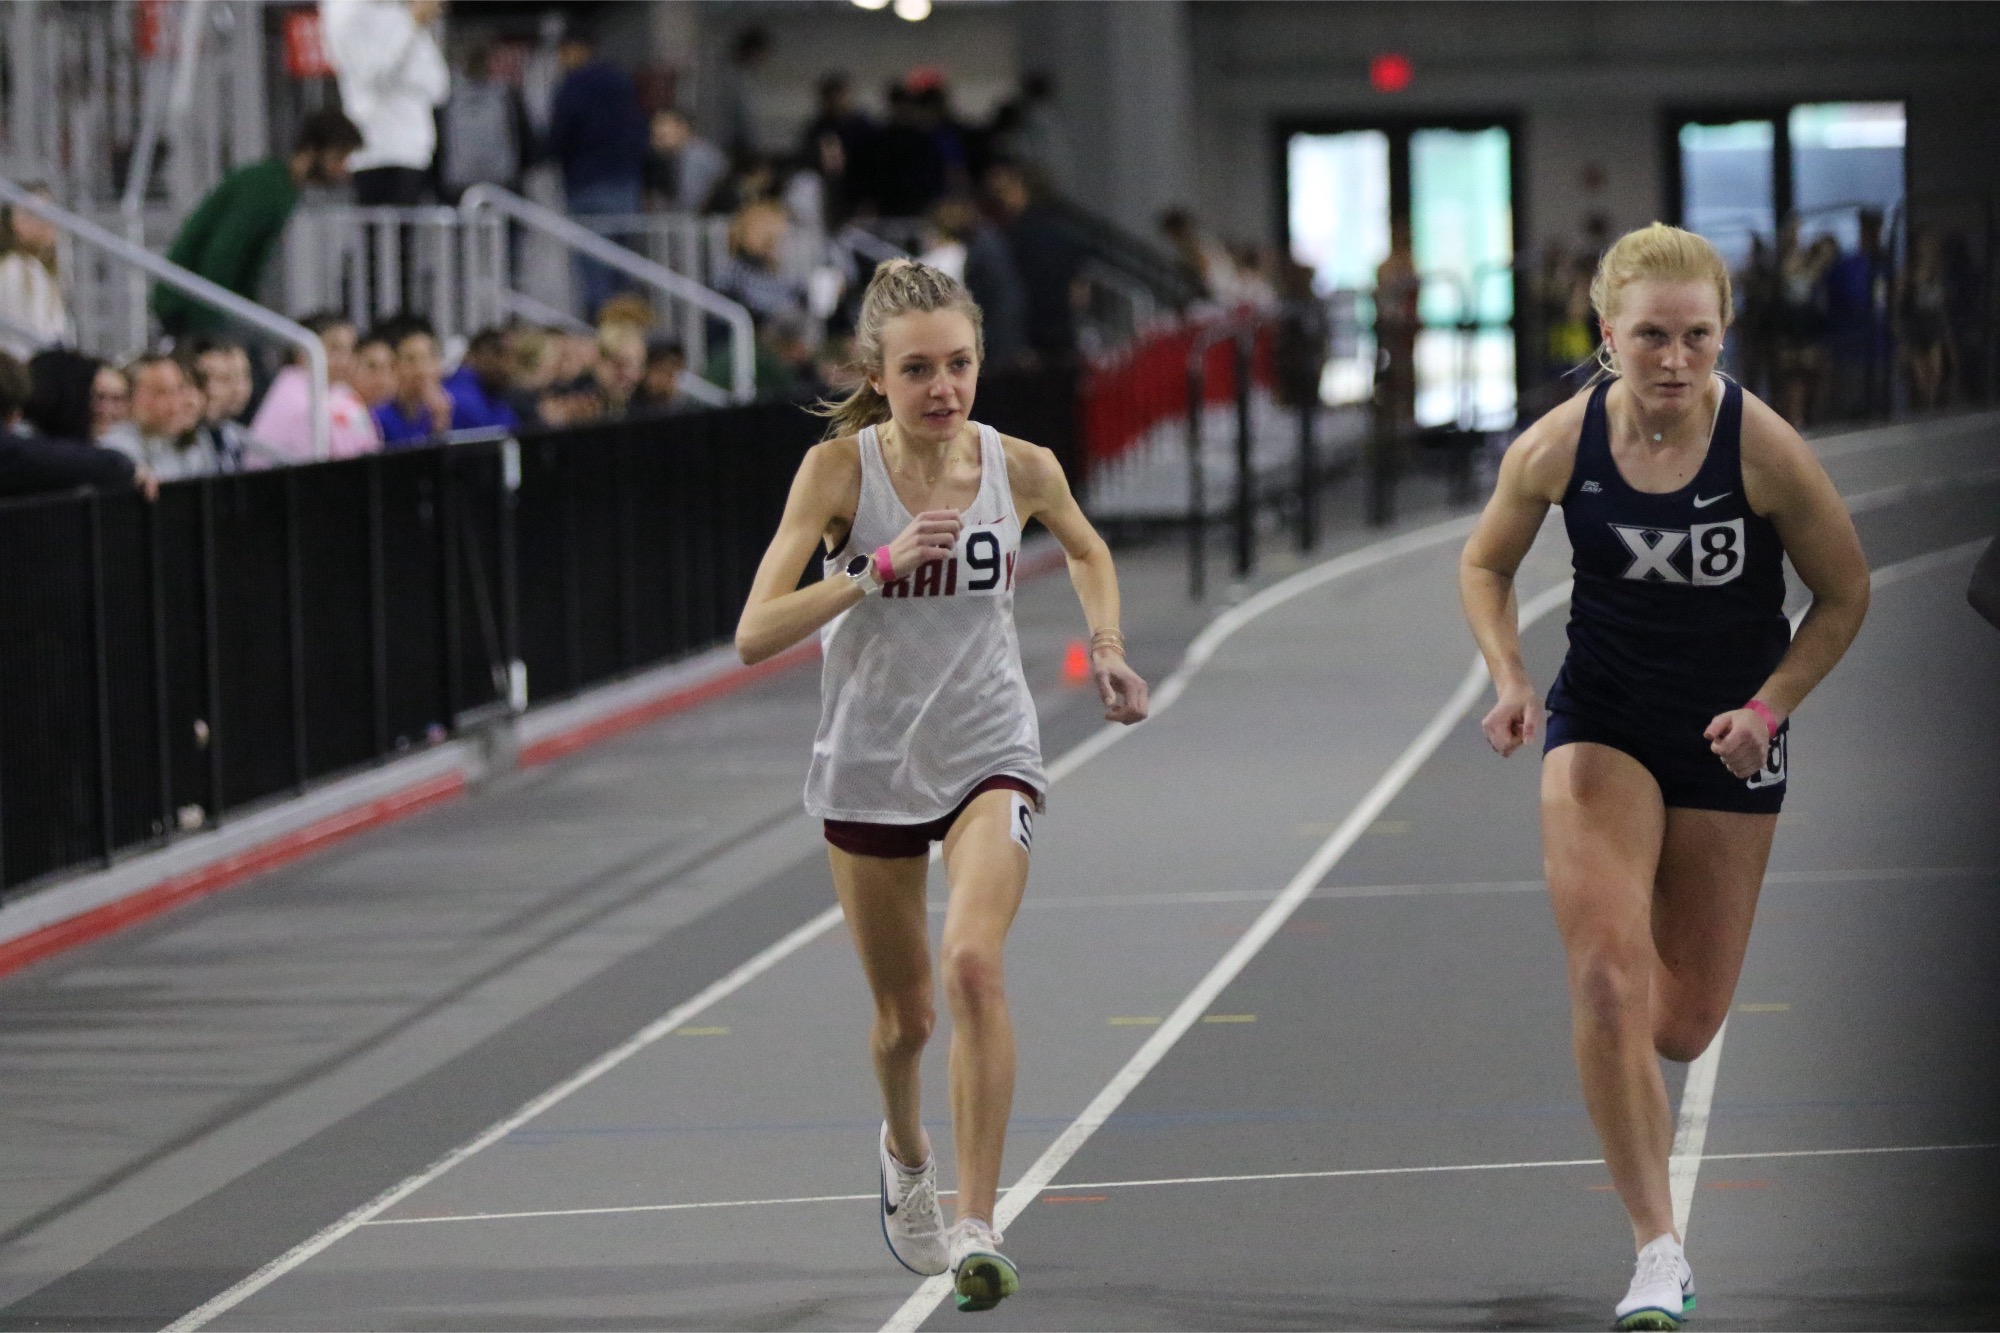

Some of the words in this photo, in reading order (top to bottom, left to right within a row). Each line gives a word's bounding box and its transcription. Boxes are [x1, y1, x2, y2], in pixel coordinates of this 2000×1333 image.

[966, 531, 1001, 590] 9
[1608, 523, 1692, 584] X
[1700, 526, 1738, 577] 8
